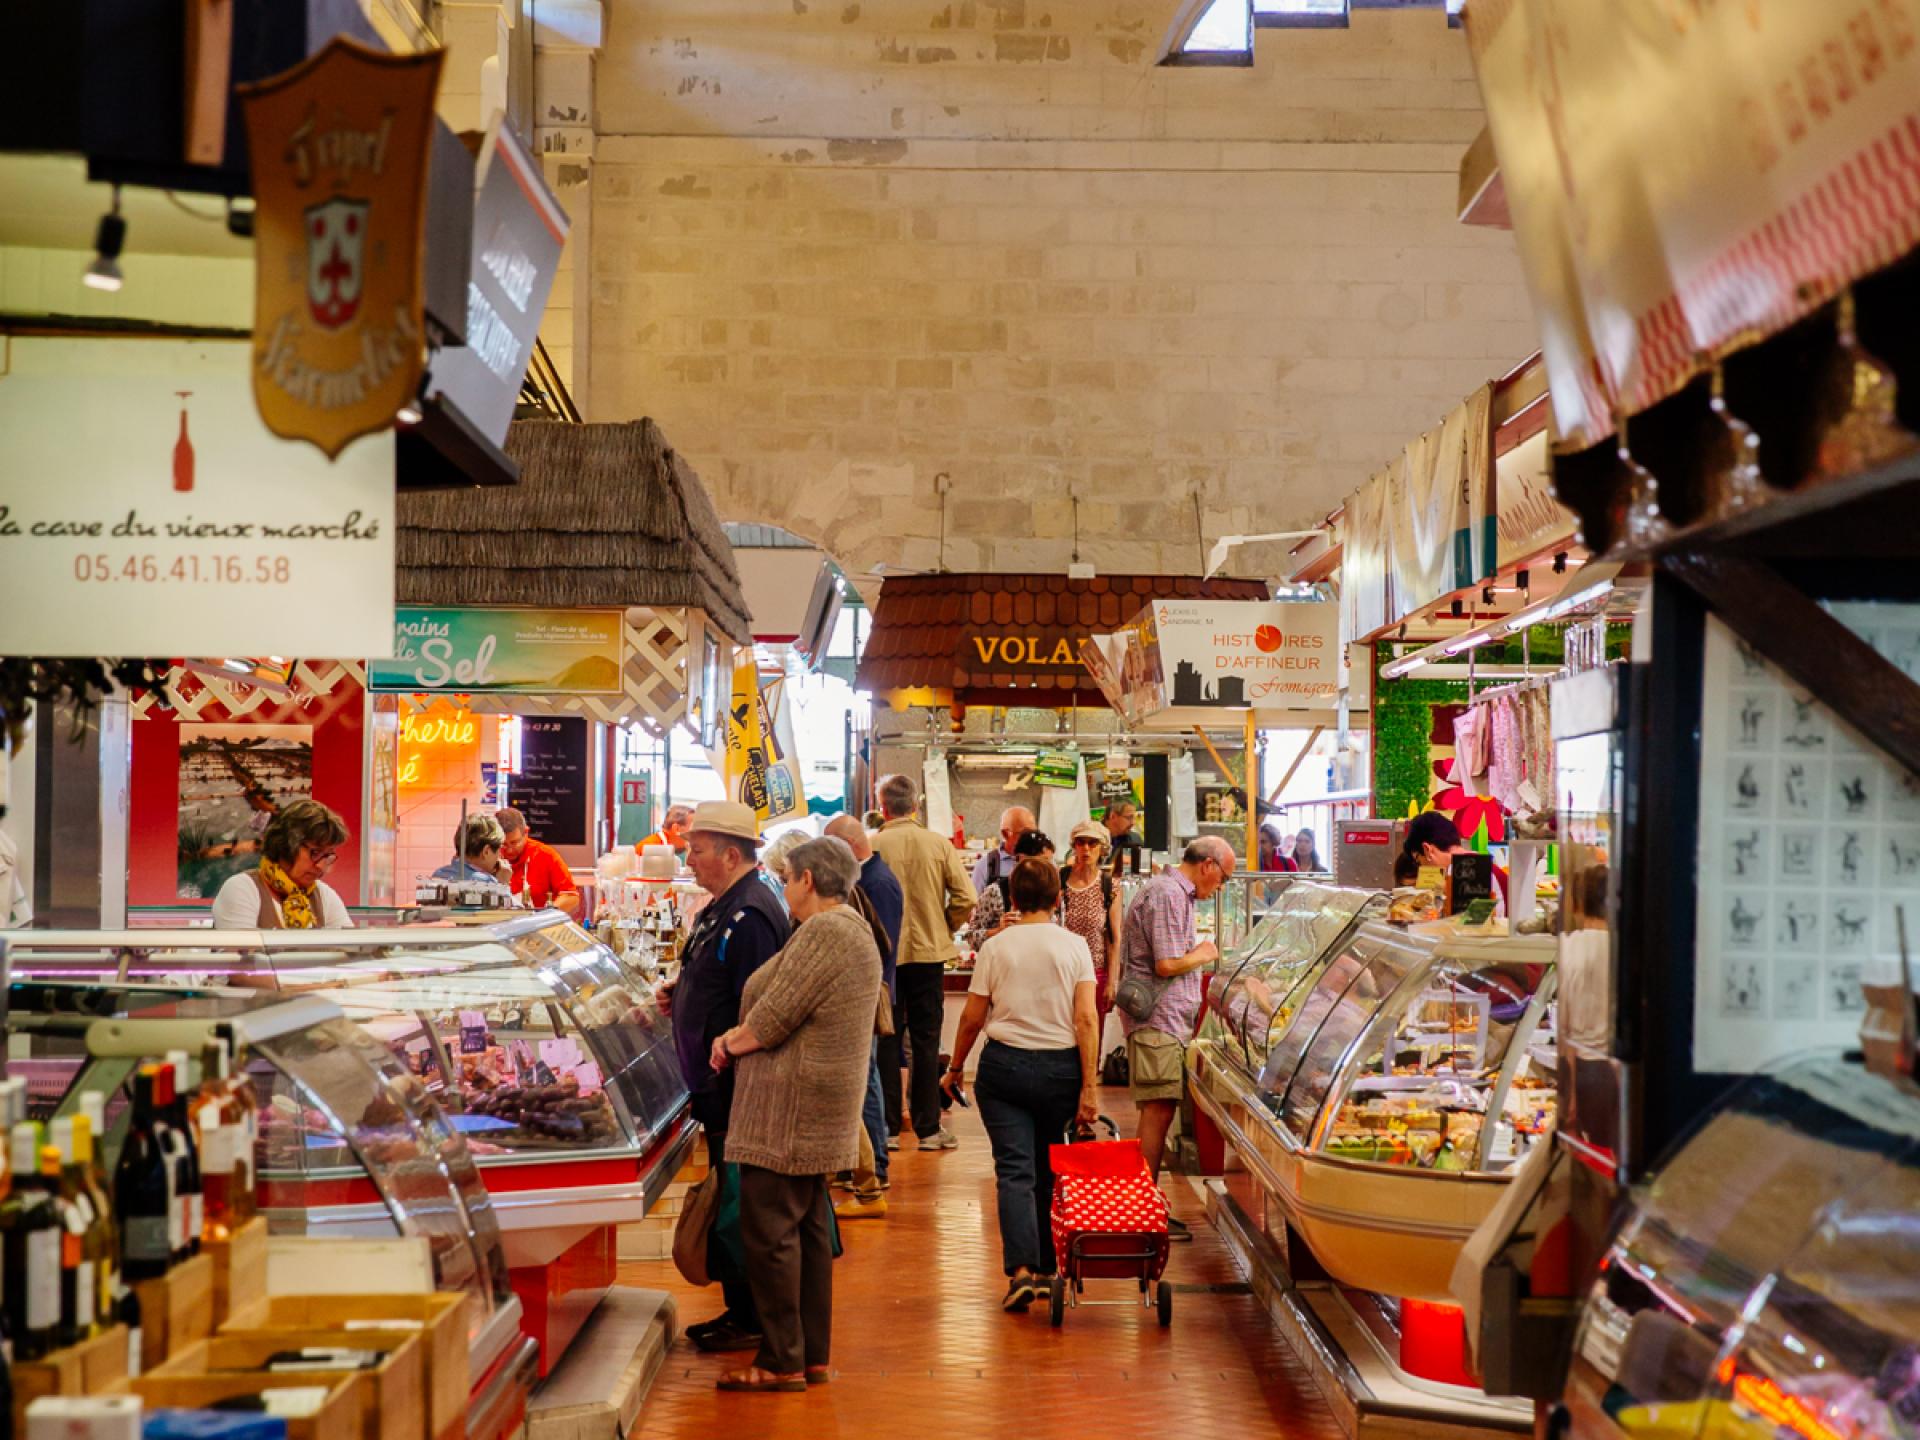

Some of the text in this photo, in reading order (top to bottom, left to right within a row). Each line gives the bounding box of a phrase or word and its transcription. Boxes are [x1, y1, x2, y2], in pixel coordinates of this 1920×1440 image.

[30, 519, 103, 537] cave
[111, 510, 156, 537] du
[165, 515, 254, 538] vieux
[261, 510, 380, 539] marché
[74, 554, 291, 583] 05.46.41.16.58
[396, 616, 450, 637] rains
[415, 634, 497, 687] Sel
[1215, 656, 1321, 670] D'AFFINEUR
[398, 708, 474, 743] cherie
